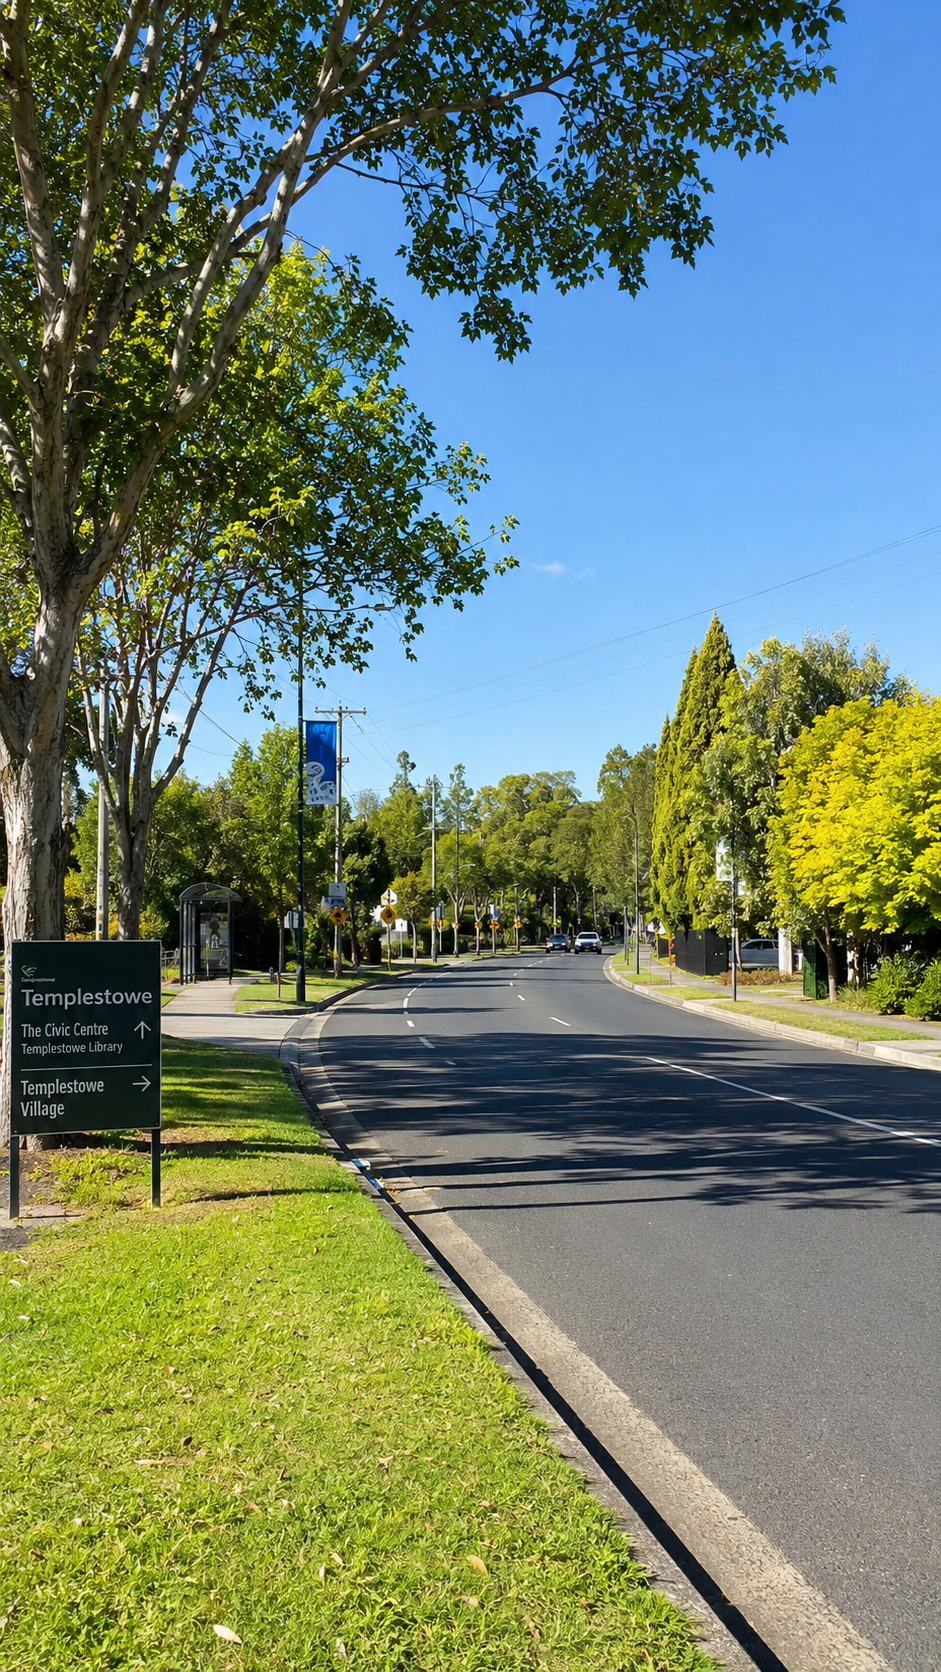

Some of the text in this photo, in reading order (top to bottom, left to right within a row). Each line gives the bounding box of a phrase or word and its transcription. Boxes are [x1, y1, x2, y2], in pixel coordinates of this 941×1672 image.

[21, 988, 153, 1010] Templestowe
[21, 1022, 109, 1038] The Civic Centre
[21, 1041, 123, 1056] Templestowe Library
[21, 1079, 104, 1098] Templestowe
[21, 1101, 65, 1119] Village
